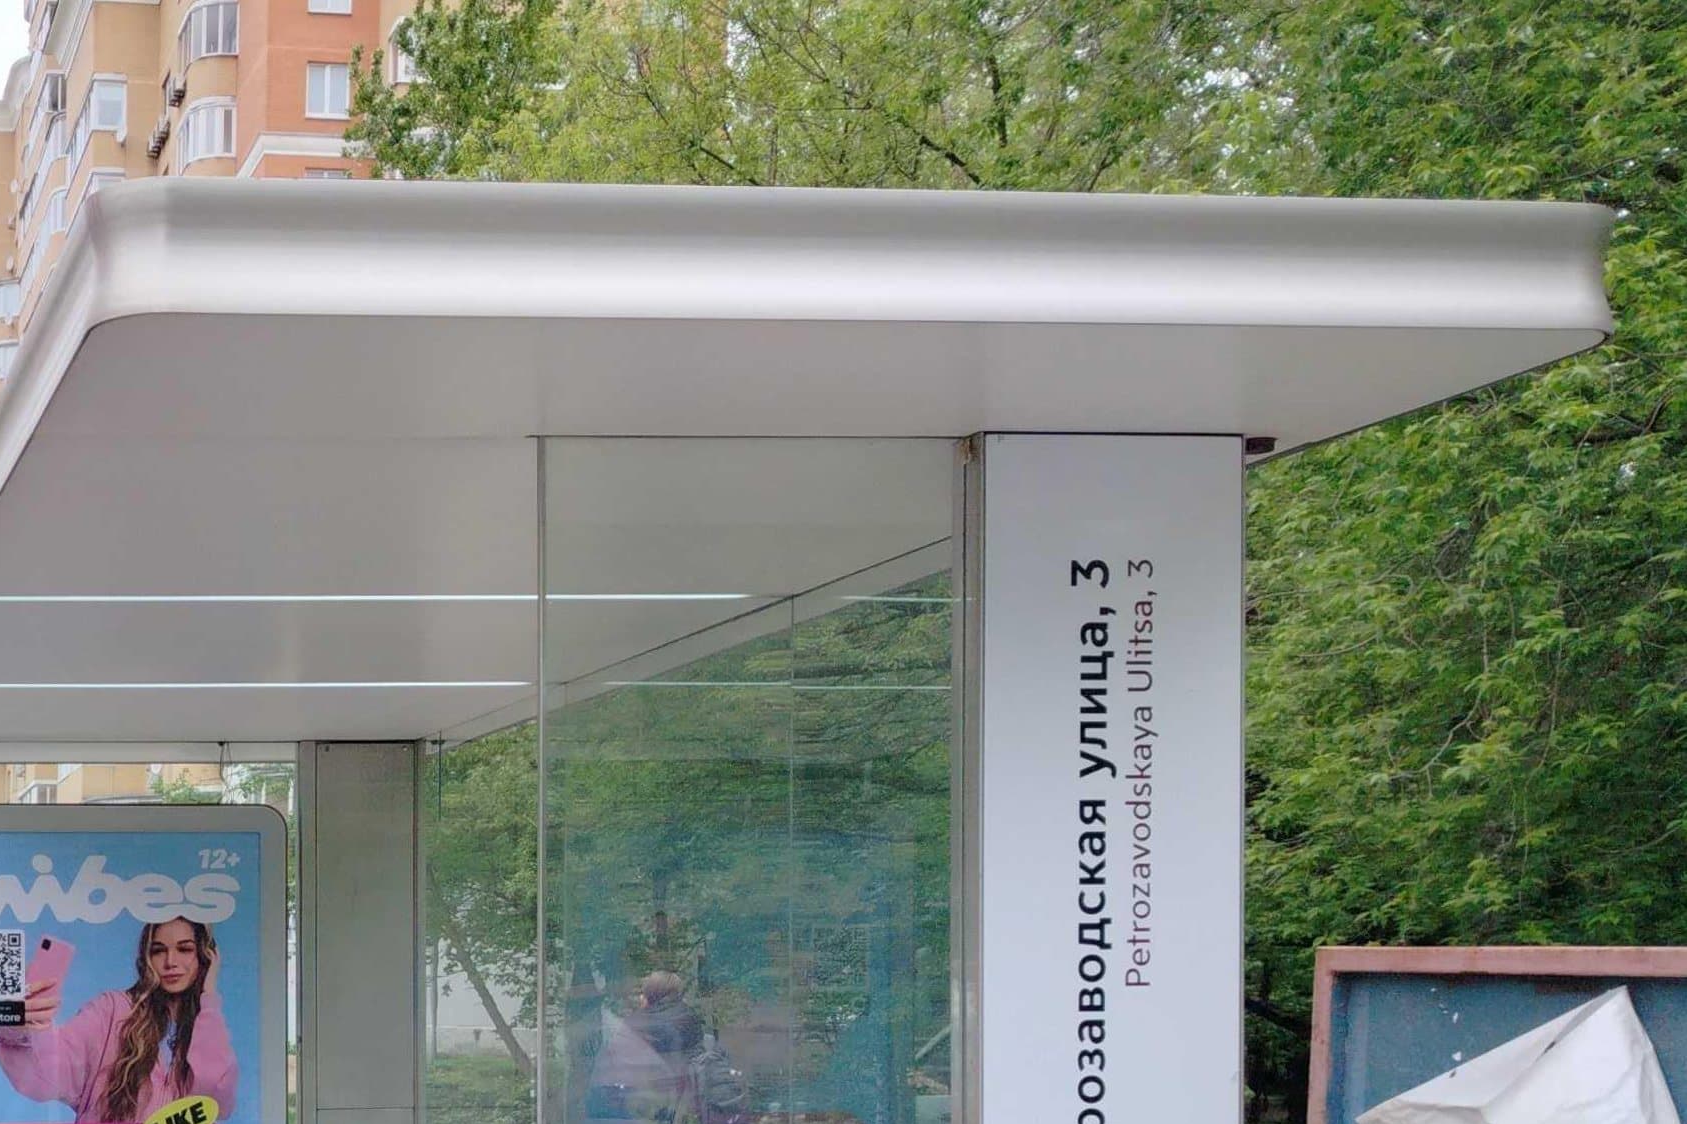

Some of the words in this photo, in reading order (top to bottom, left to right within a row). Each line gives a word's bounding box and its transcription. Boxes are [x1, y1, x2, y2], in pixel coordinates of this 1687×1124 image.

[1070, 559, 1110, 588] 3
[1127, 558, 1154, 579] 3
[1126, 590, 1158, 693] Ulitsa,
[1078, 606, 1117, 779] улица,
[198, 848, 241, 869] 12+
[1124, 704, 1159, 988] Petrozavodskaya
